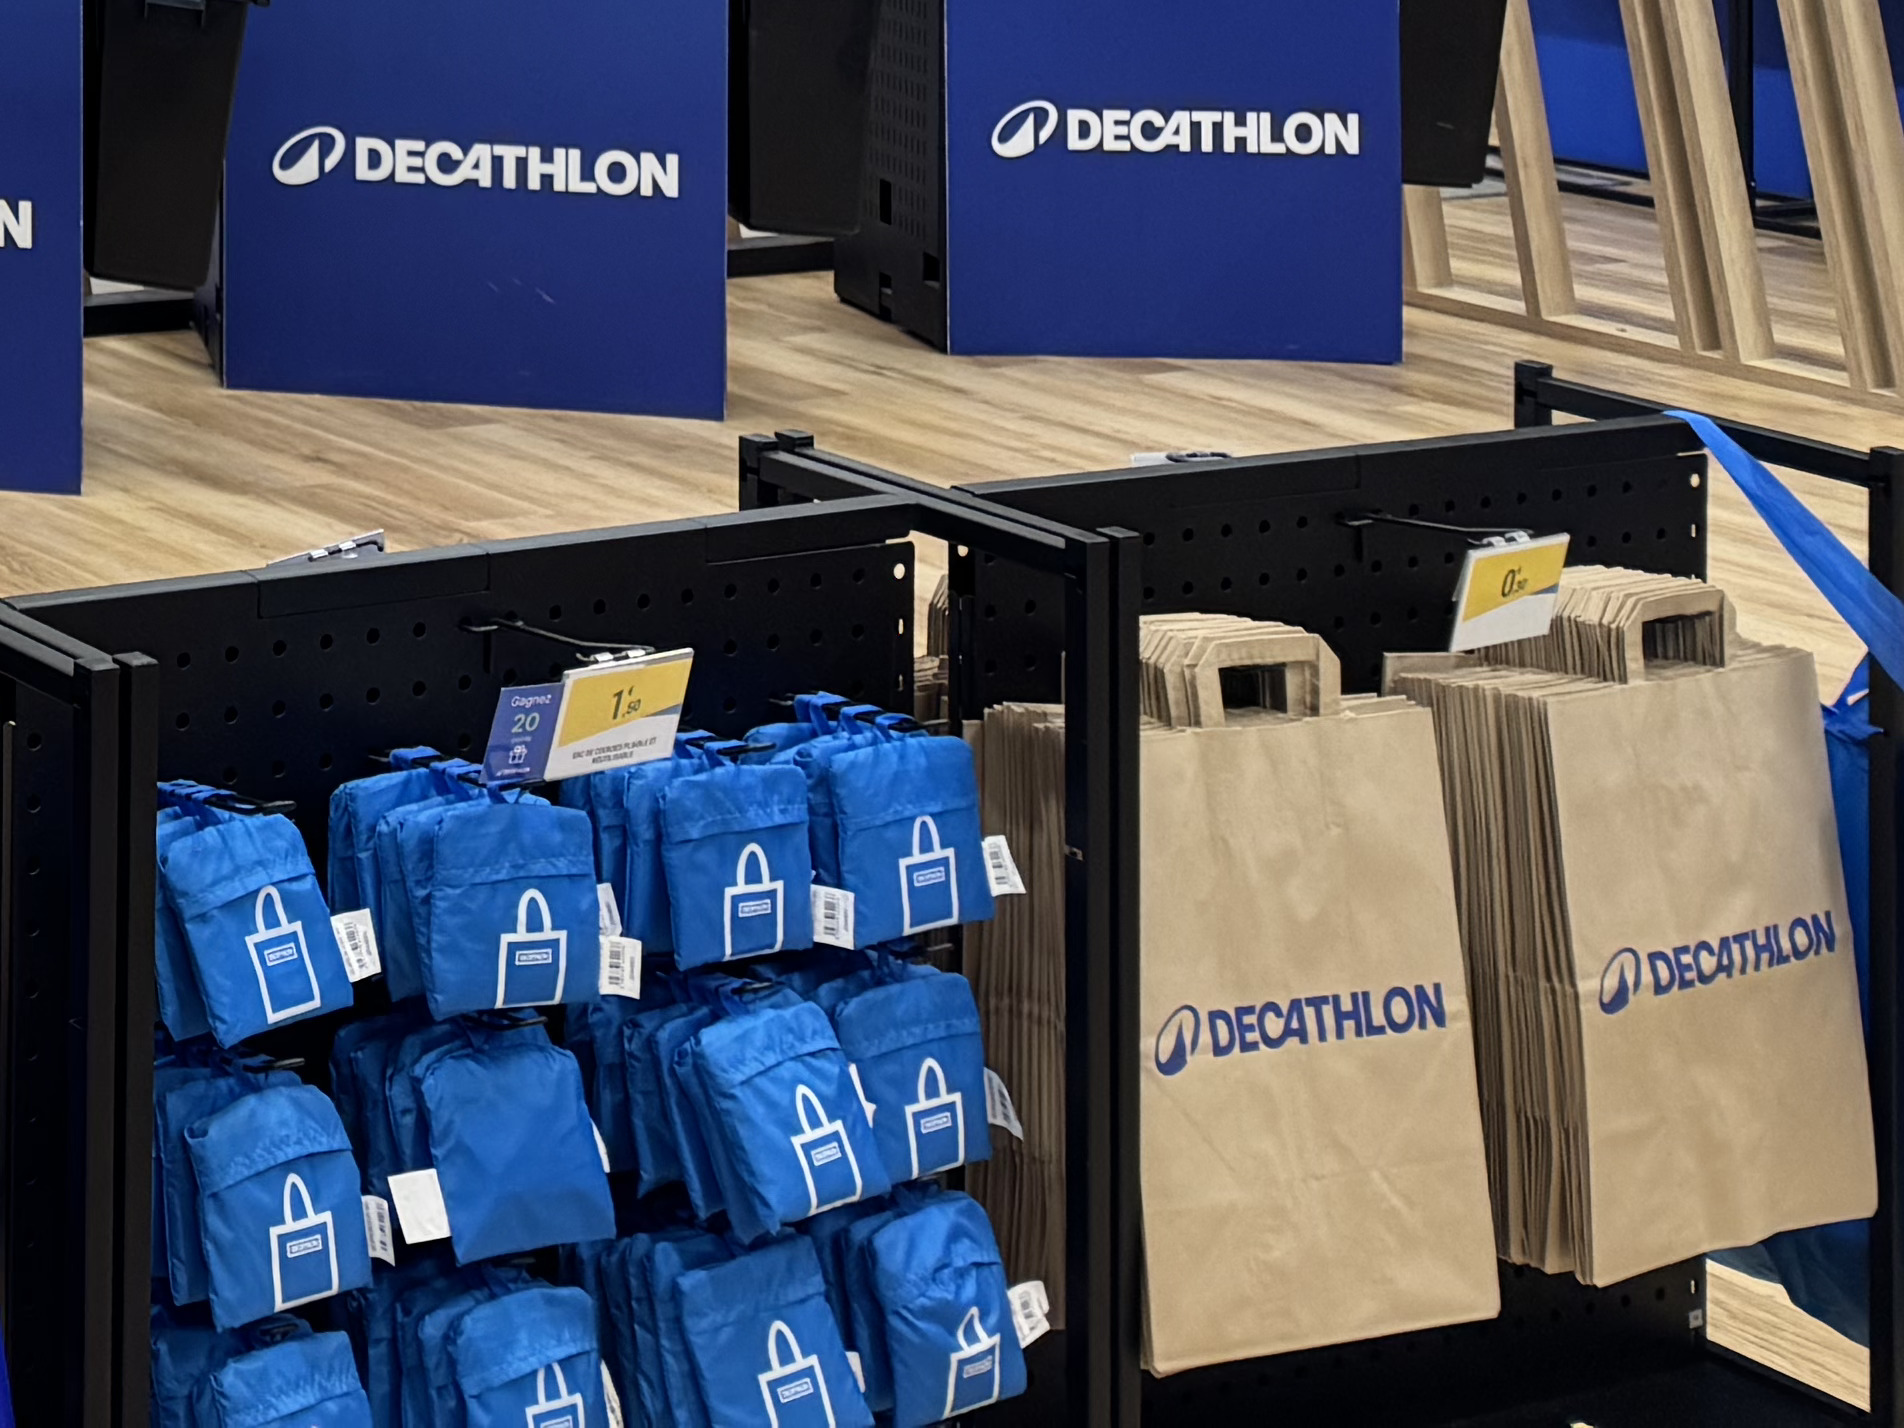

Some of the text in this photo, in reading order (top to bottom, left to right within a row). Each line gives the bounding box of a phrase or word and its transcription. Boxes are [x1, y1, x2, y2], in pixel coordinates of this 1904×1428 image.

[1066, 108, 1360, 156] DECATHLON
[355, 136, 679, 198] DECATHLON
[510, 711, 540, 733] 20
[511, 693, 552, 709] Gagnez
[1648, 910, 1836, 997] DECATHLON
[1208, 982, 1447, 1060] DECATHLON
